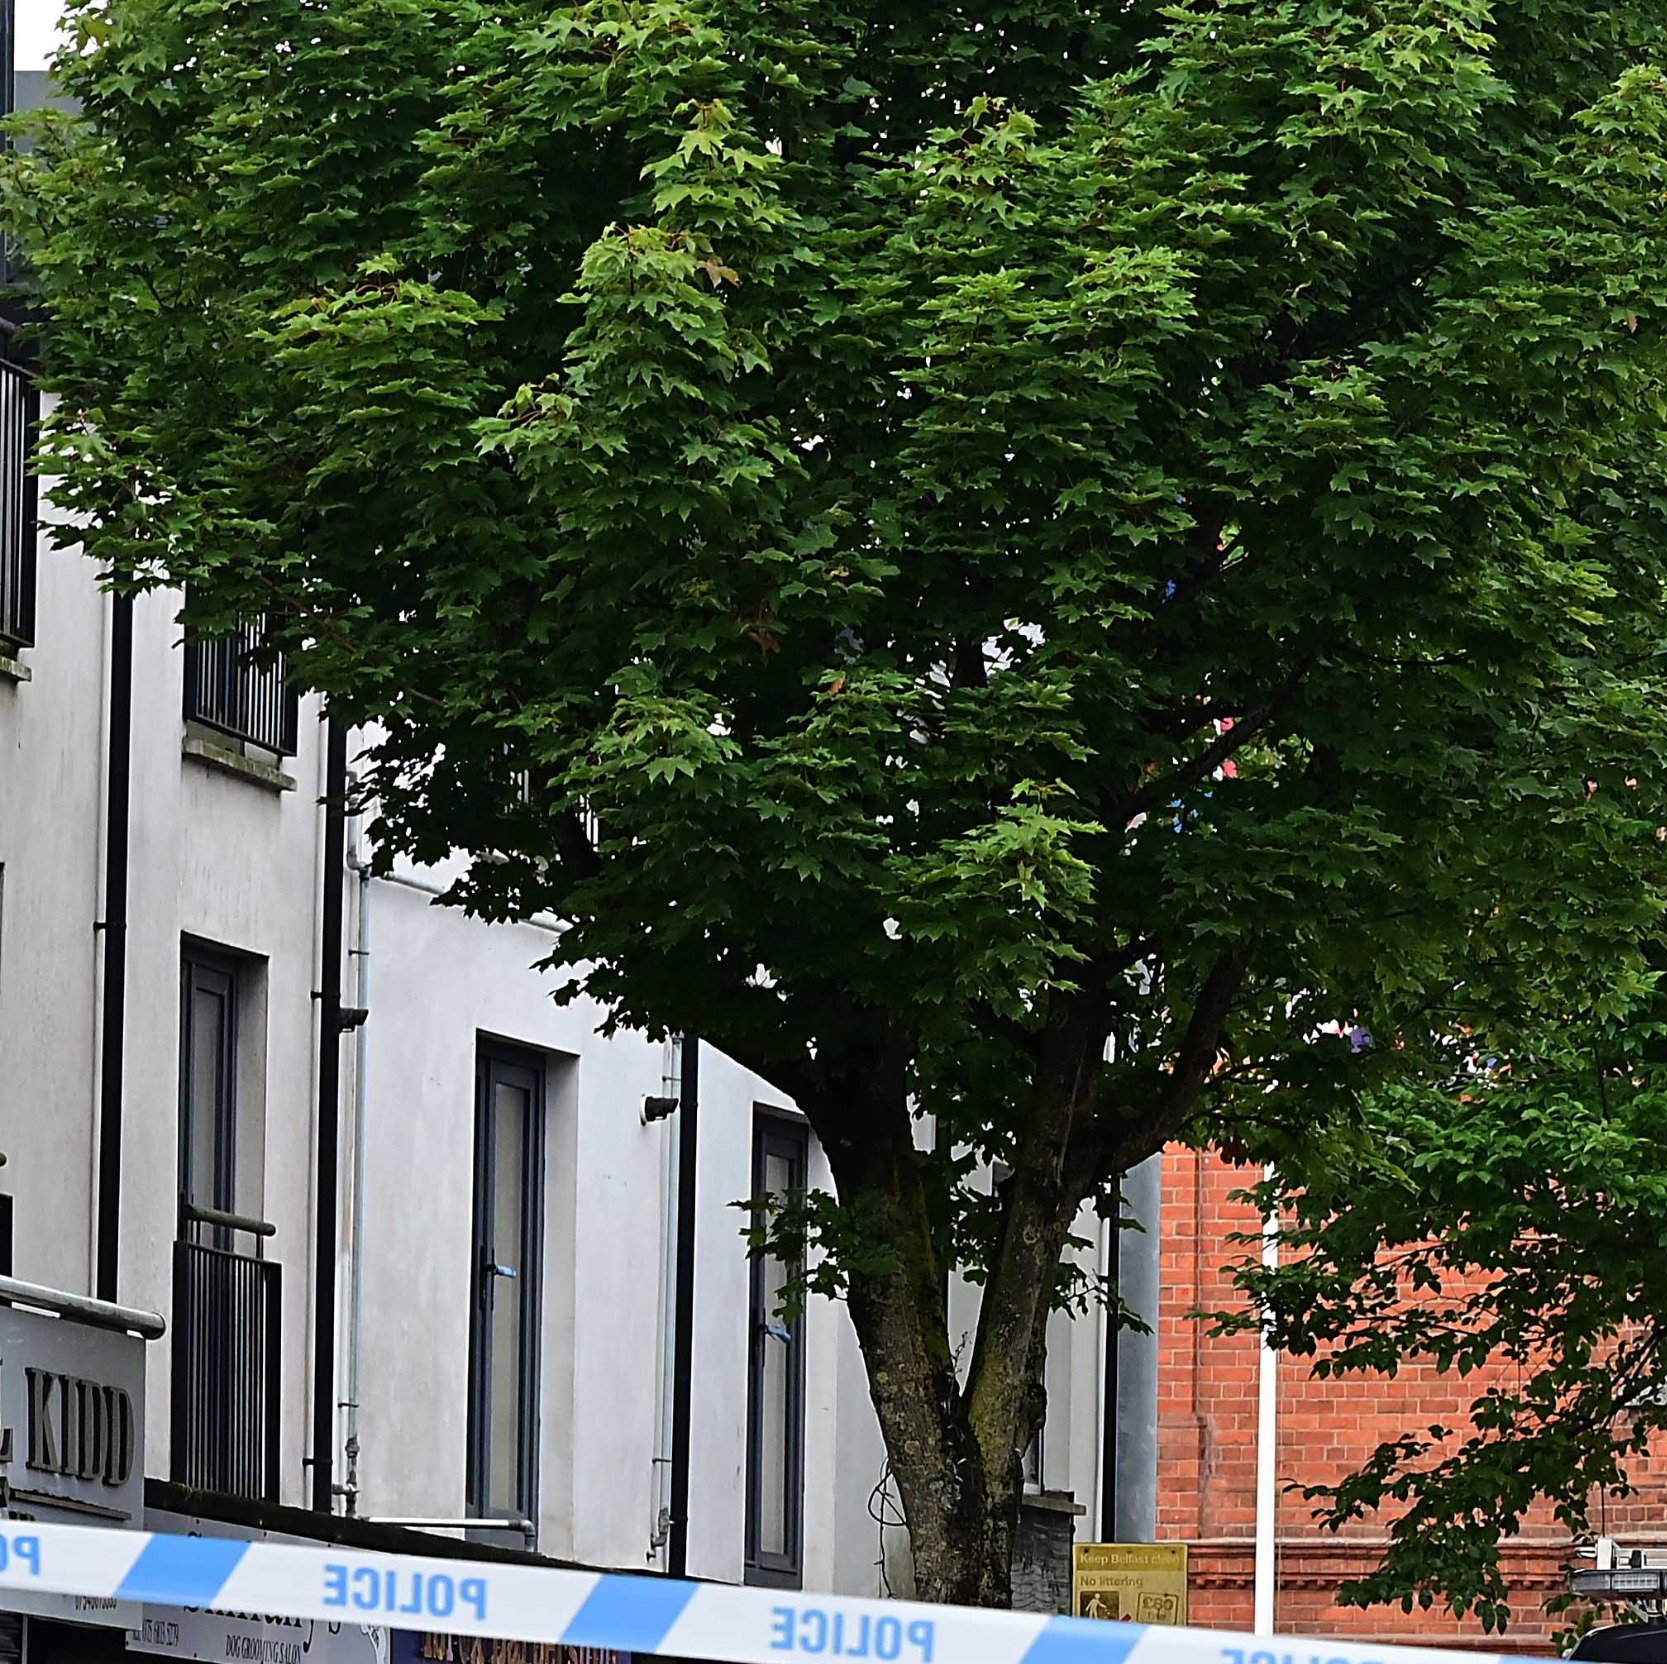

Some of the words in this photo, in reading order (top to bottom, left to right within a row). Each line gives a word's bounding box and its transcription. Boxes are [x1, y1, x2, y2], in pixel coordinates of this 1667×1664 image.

[25, 1366, 136, 1487] KIDD
[1080, 1554, 1108, 1566] Keep
[1111, 1553, 1148, 1564] Belfast
[1080, 1576, 1097, 1587] No
[1099, 1576, 1143, 1588] littering
[226, 1634, 241, 1658] DOG
